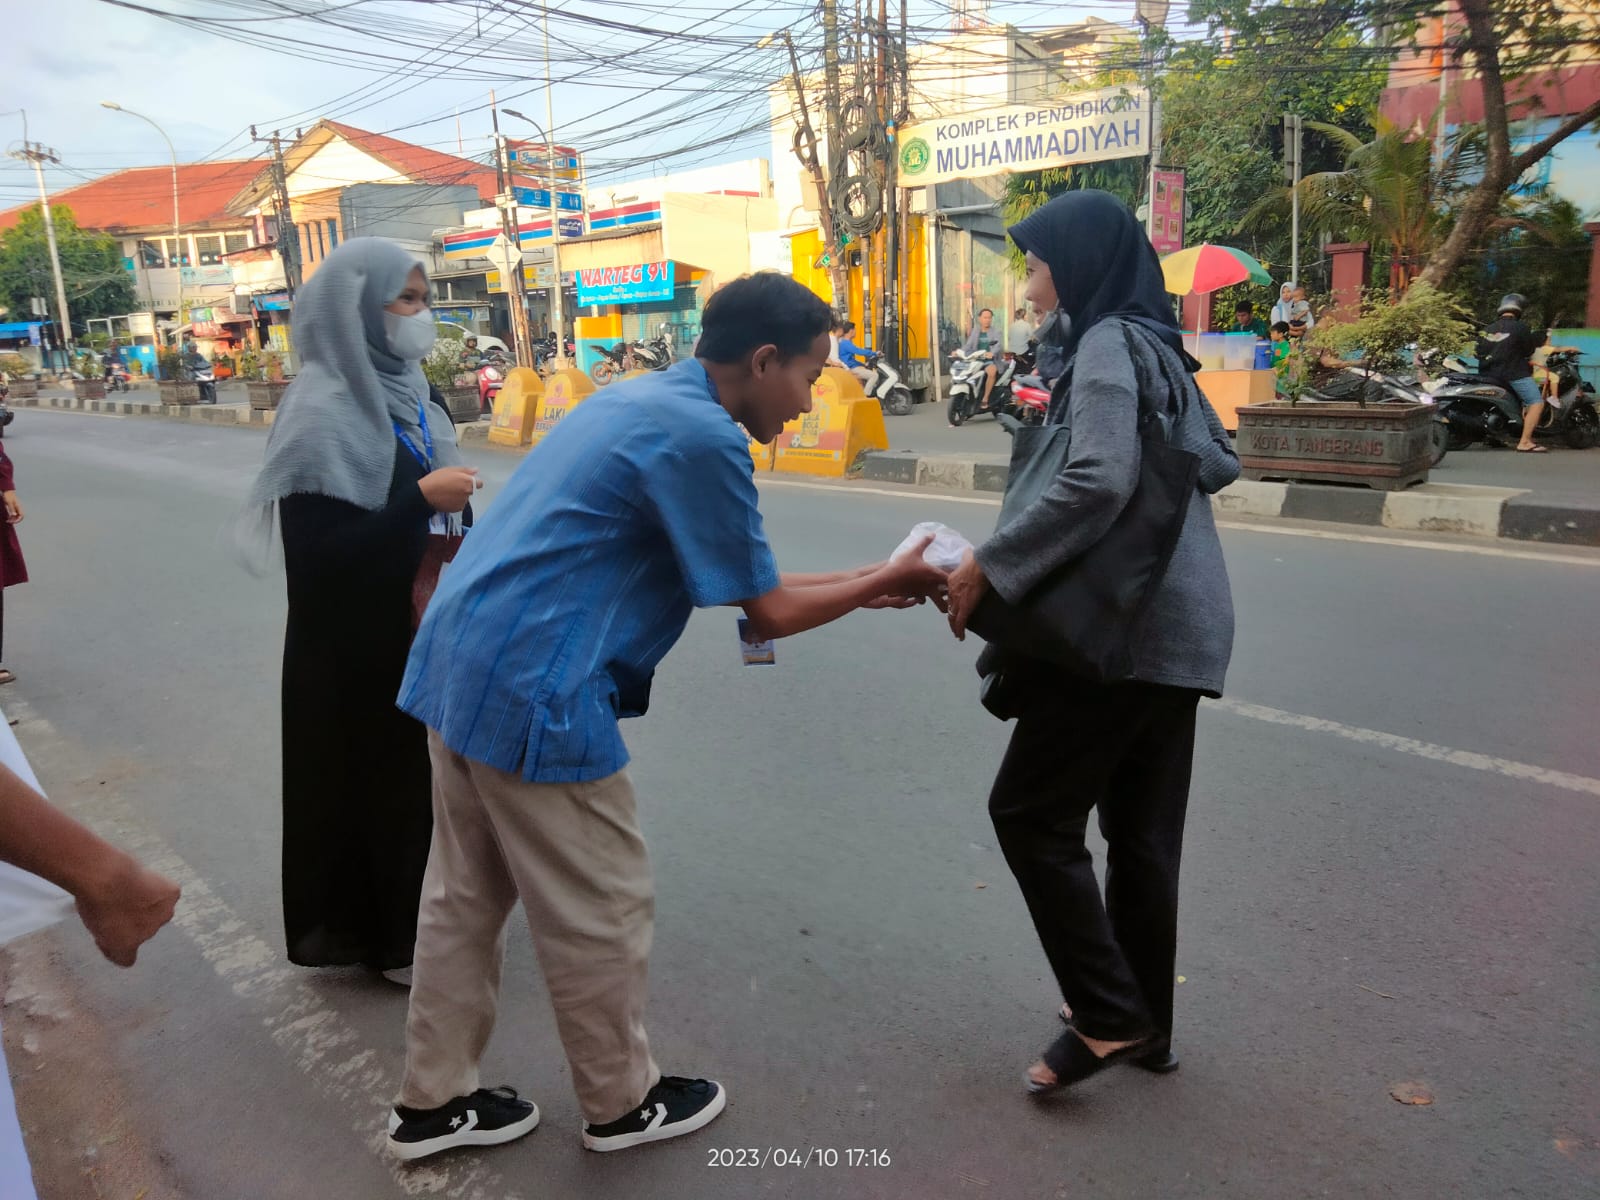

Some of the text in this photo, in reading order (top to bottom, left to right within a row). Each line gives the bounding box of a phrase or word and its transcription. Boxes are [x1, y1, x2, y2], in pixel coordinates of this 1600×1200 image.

[936, 95, 1141, 141] KOMPLEK PENDIDIKAN
[936, 118, 1141, 174] MUHAMMADIYAH
[580, 261, 669, 288] WARTEG 91
[1251, 434, 1384, 456] KOTA TANGERANG
